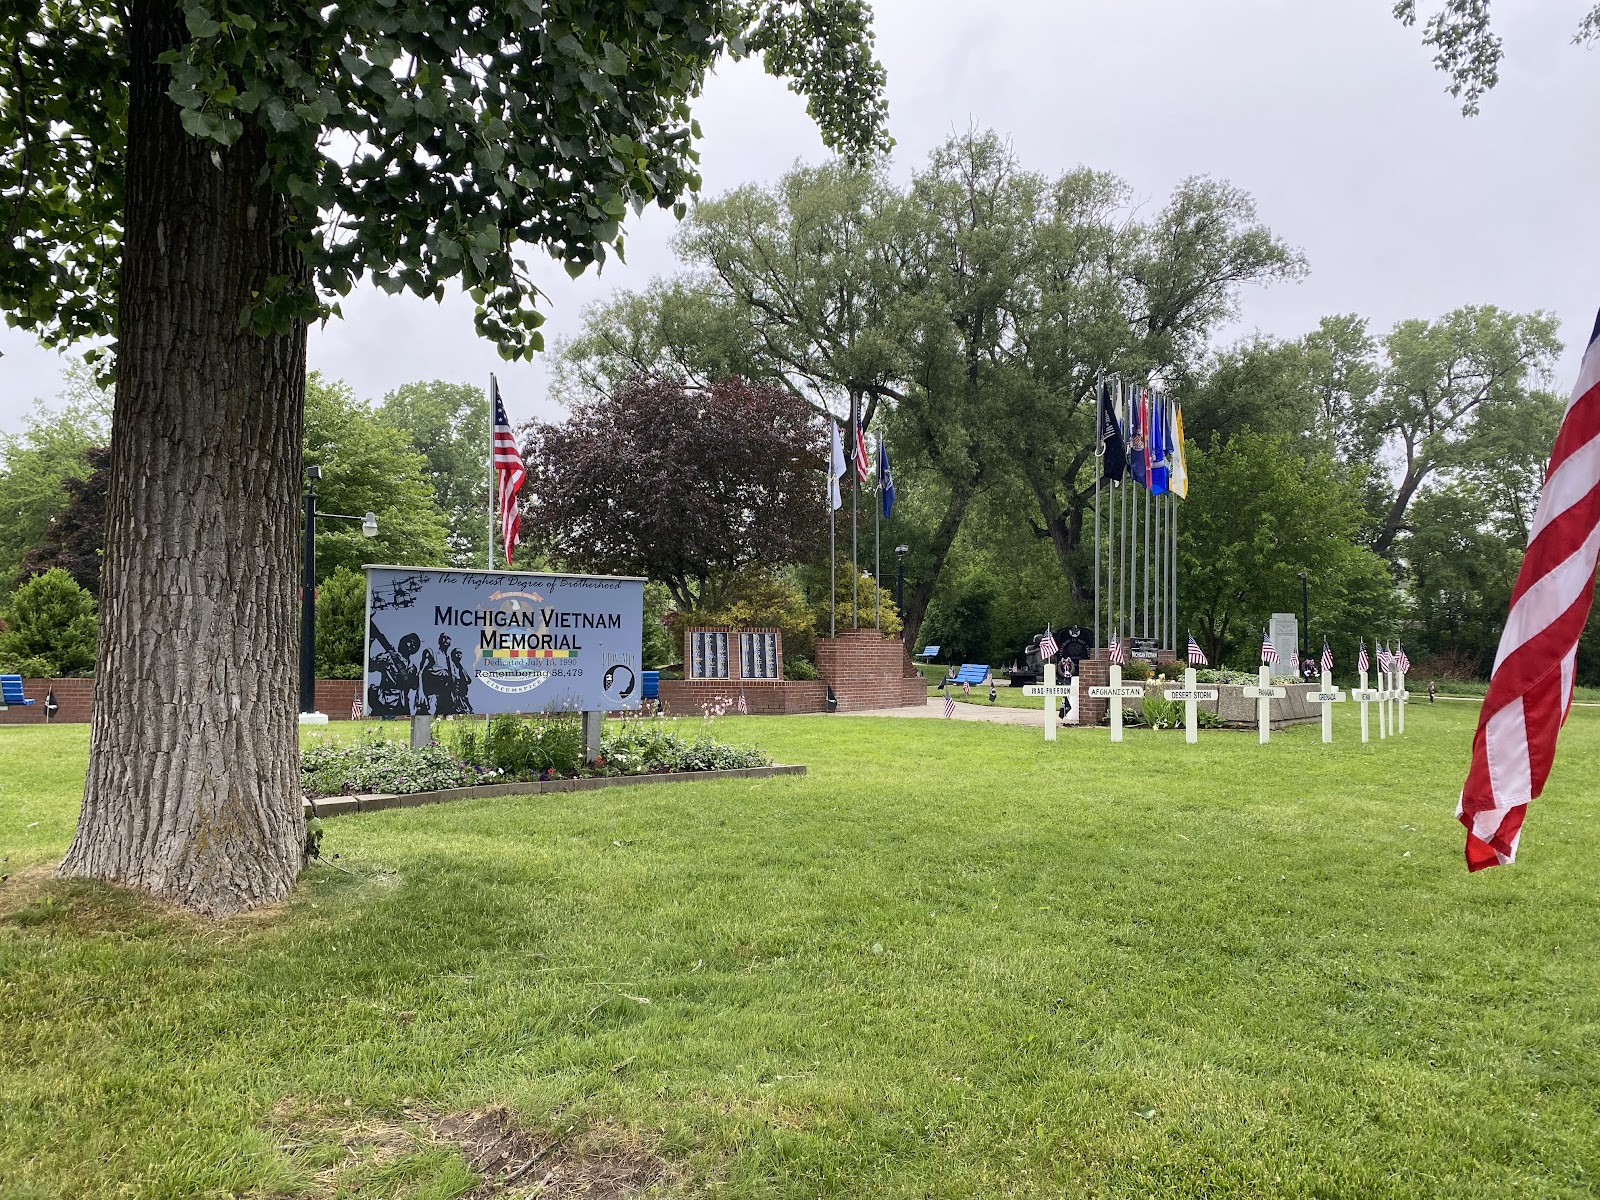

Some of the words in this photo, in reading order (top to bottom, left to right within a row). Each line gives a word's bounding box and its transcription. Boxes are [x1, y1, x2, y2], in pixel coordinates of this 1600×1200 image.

[438, 572, 458, 583] The
[462, 573, 506, 589] Highest
[507, 576, 544, 591] Degree
[546, 578, 558, 593] of
[560, 577, 622, 590] Brotherhood
[434, 605, 535, 628] MICHIGAN
[540, 608, 621, 629] VIETNAM
[480, 629, 582, 650] MEMORIAL
[484, 658, 523, 667] Dedicated
[526, 658, 542, 668] July
[545, 659, 557, 668] 15,
[560, 659, 577, 667] 1990
[474, 668, 549, 679] Remembering
[551, 668, 583, 679] 58,479
[1091, 688, 1141, 696] AFGHANISTAN
[1171, 691, 1192, 699] DESERT
[1193, 691, 1212, 699] STORM
